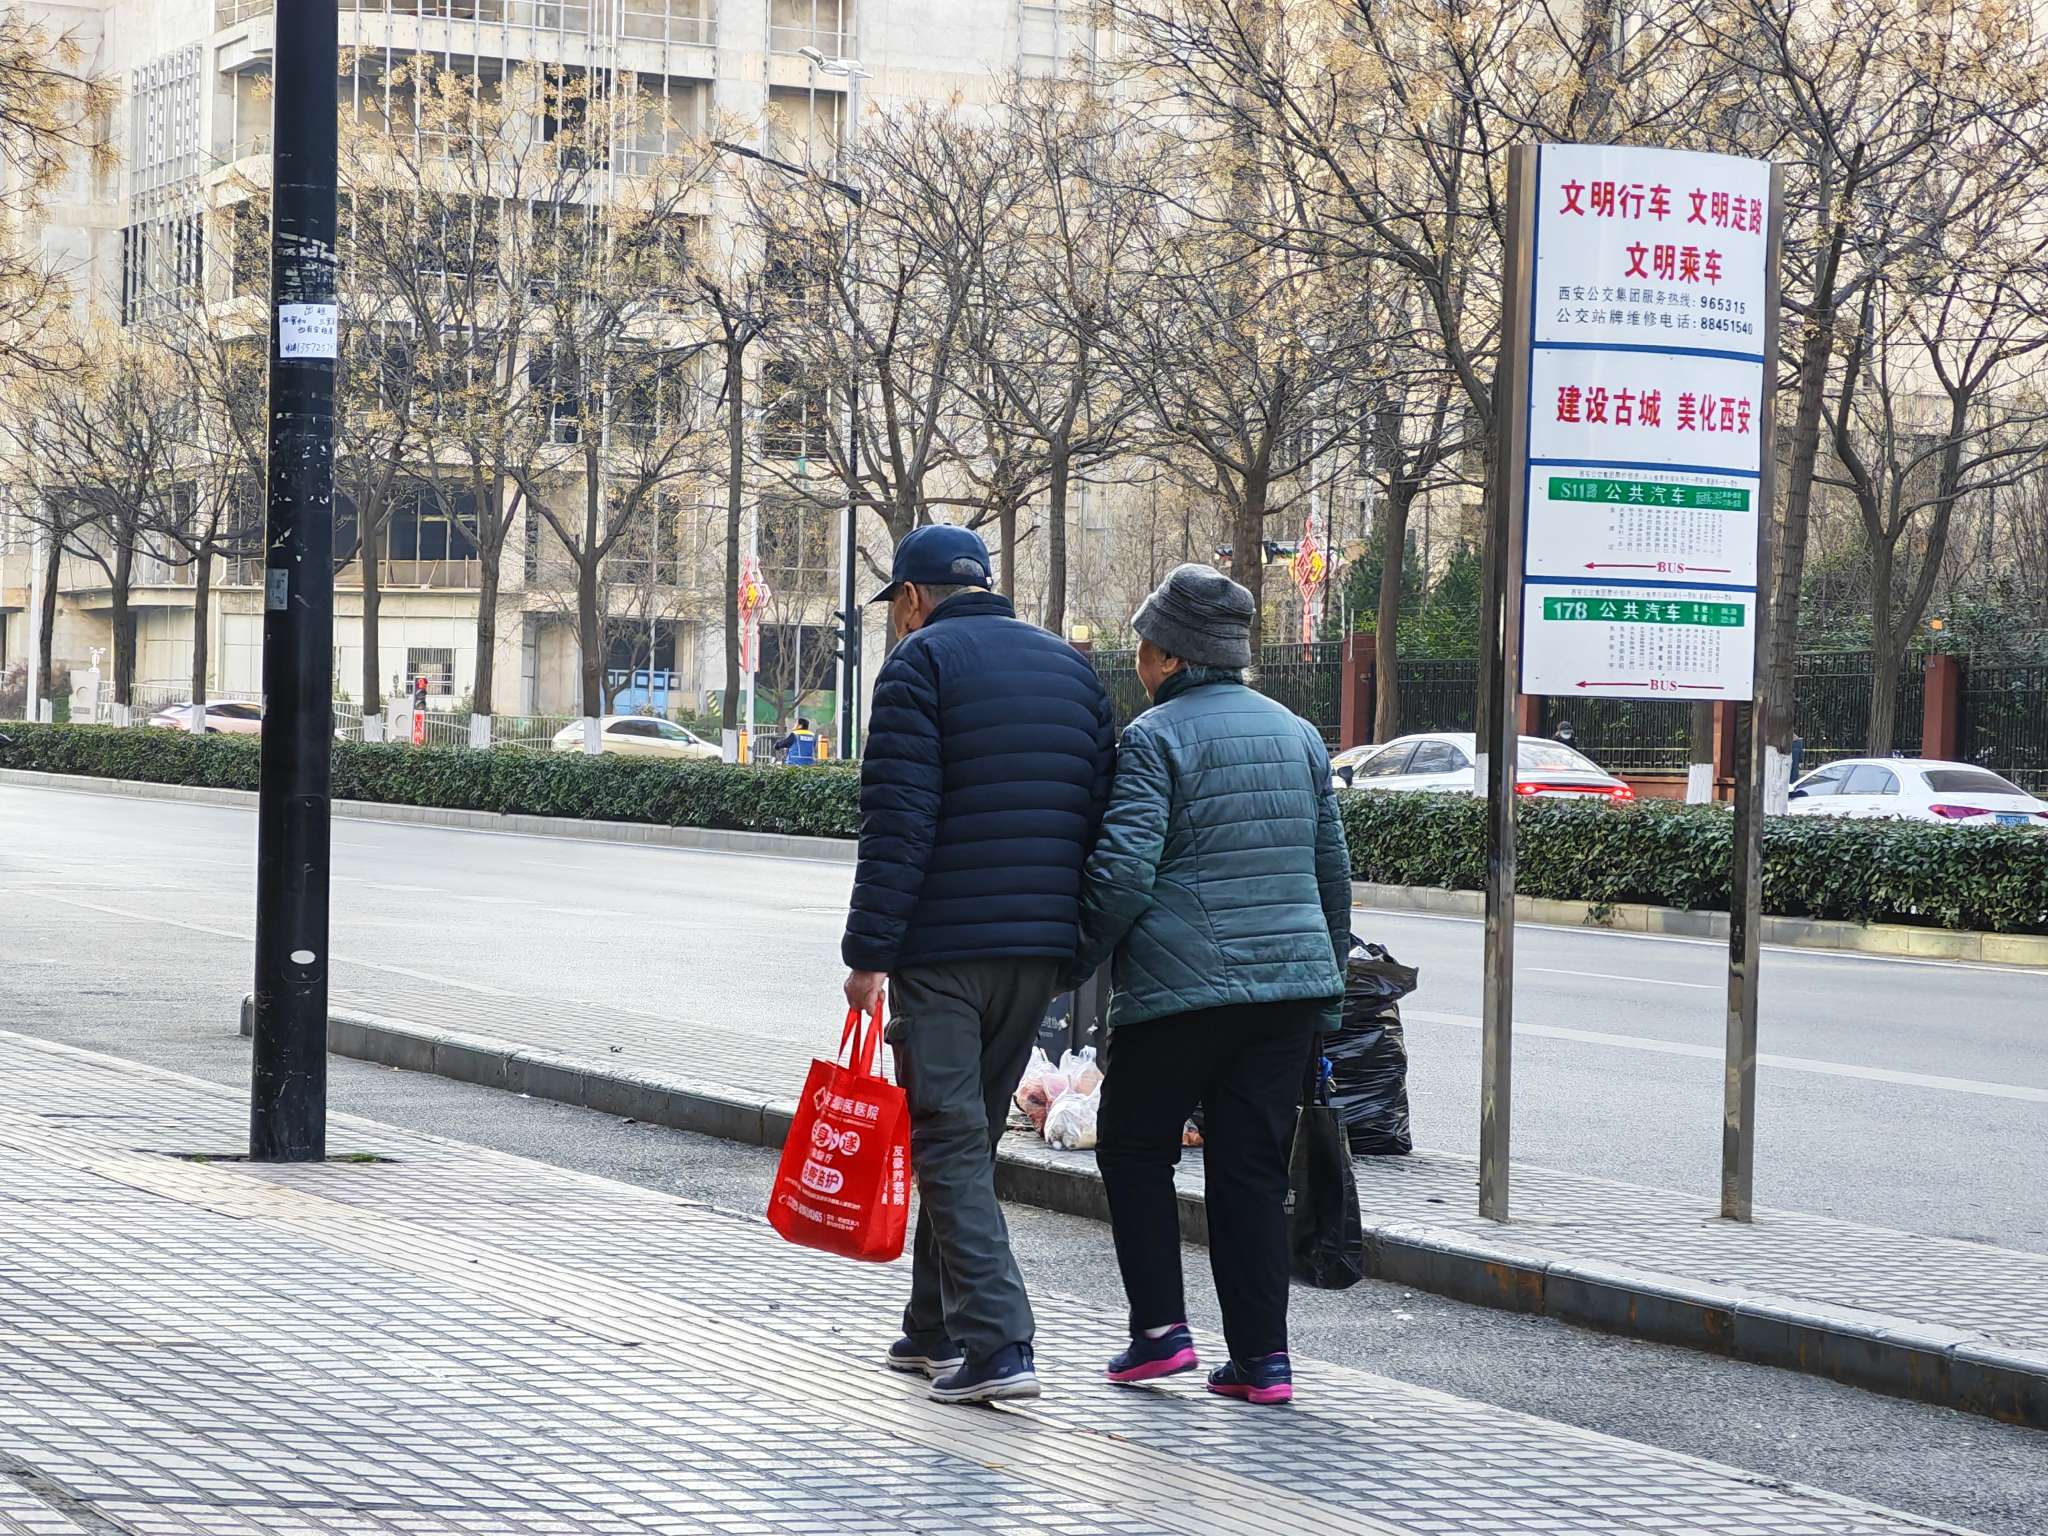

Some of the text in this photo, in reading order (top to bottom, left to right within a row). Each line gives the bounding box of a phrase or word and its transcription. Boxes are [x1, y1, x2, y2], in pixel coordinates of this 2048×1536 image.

[1559, 179, 1762, 236] 文明行车 文明走路
[1624, 241, 1723, 286] 文明乘车
[1555, 384, 1752, 435] 建设古城 美化西安
[1604, 483, 1686, 506] 公共汽车
[1656, 561, 1685, 574] BUS
[1552, 601, 1588, 621] 178
[1599, 601, 1682, 623] 公共汽车
[1649, 679, 1679, 692] BUS
